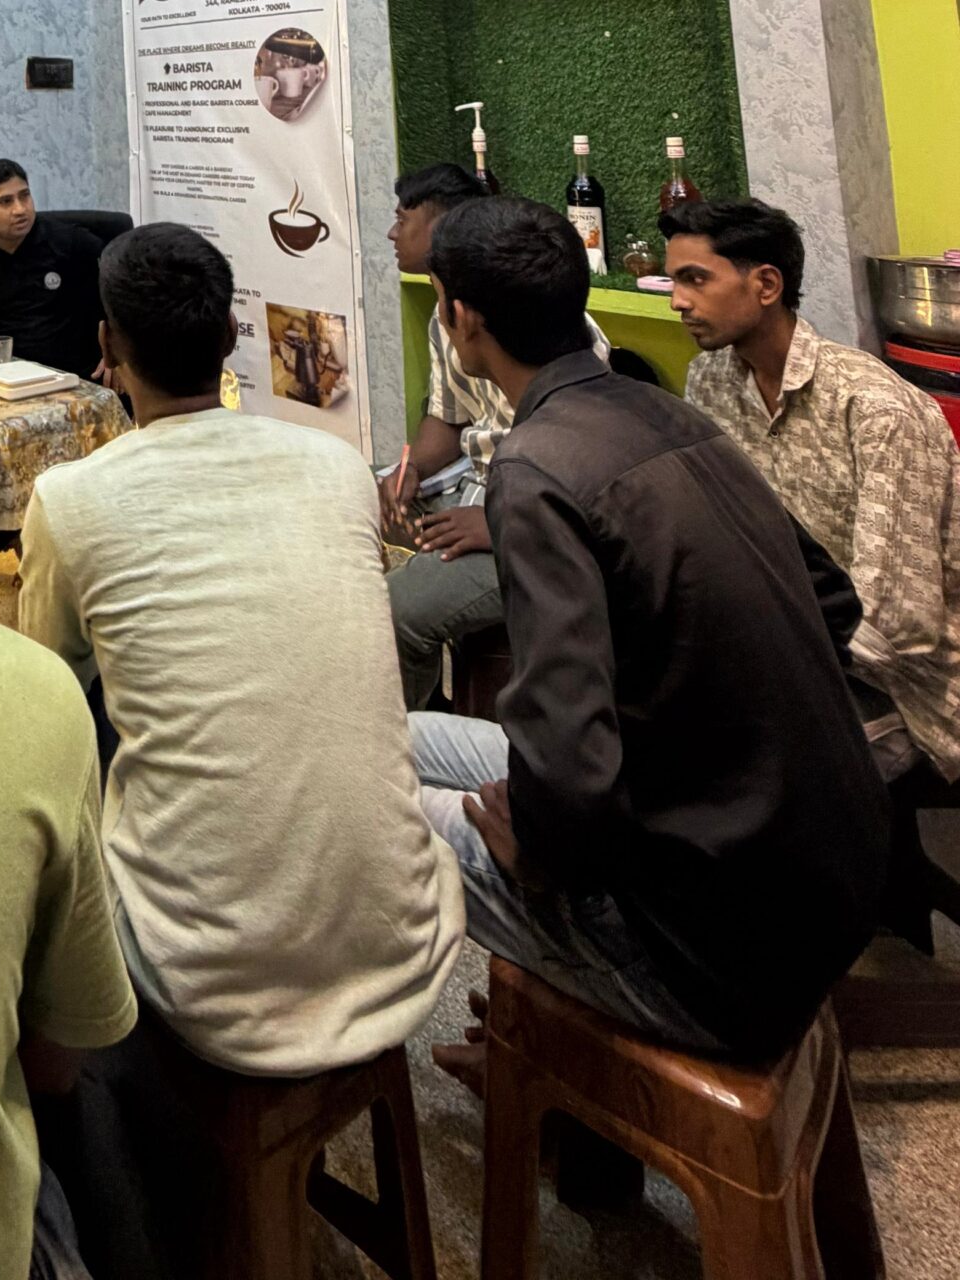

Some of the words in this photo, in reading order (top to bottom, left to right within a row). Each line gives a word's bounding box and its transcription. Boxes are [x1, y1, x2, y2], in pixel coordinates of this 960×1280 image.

[228, 5, 260, 16] KOLKATA
[265, 2, 291, 12] 700014
[182, 44, 205, 52] DREAMS
[206, 42, 229, 51] BECOME
[230, 40, 256, 49] REALITY
[173, 62, 214, 74] BARISTA
[147, 80, 188, 92] TRAINING
[190, 79, 242, 91] PROGRAM
[217, 126, 250, 134] EXCLUSIVE
[233, 288, 251, 297] KATA
[251, 289, 261, 298] TO
[239, 323, 255, 335] SE
